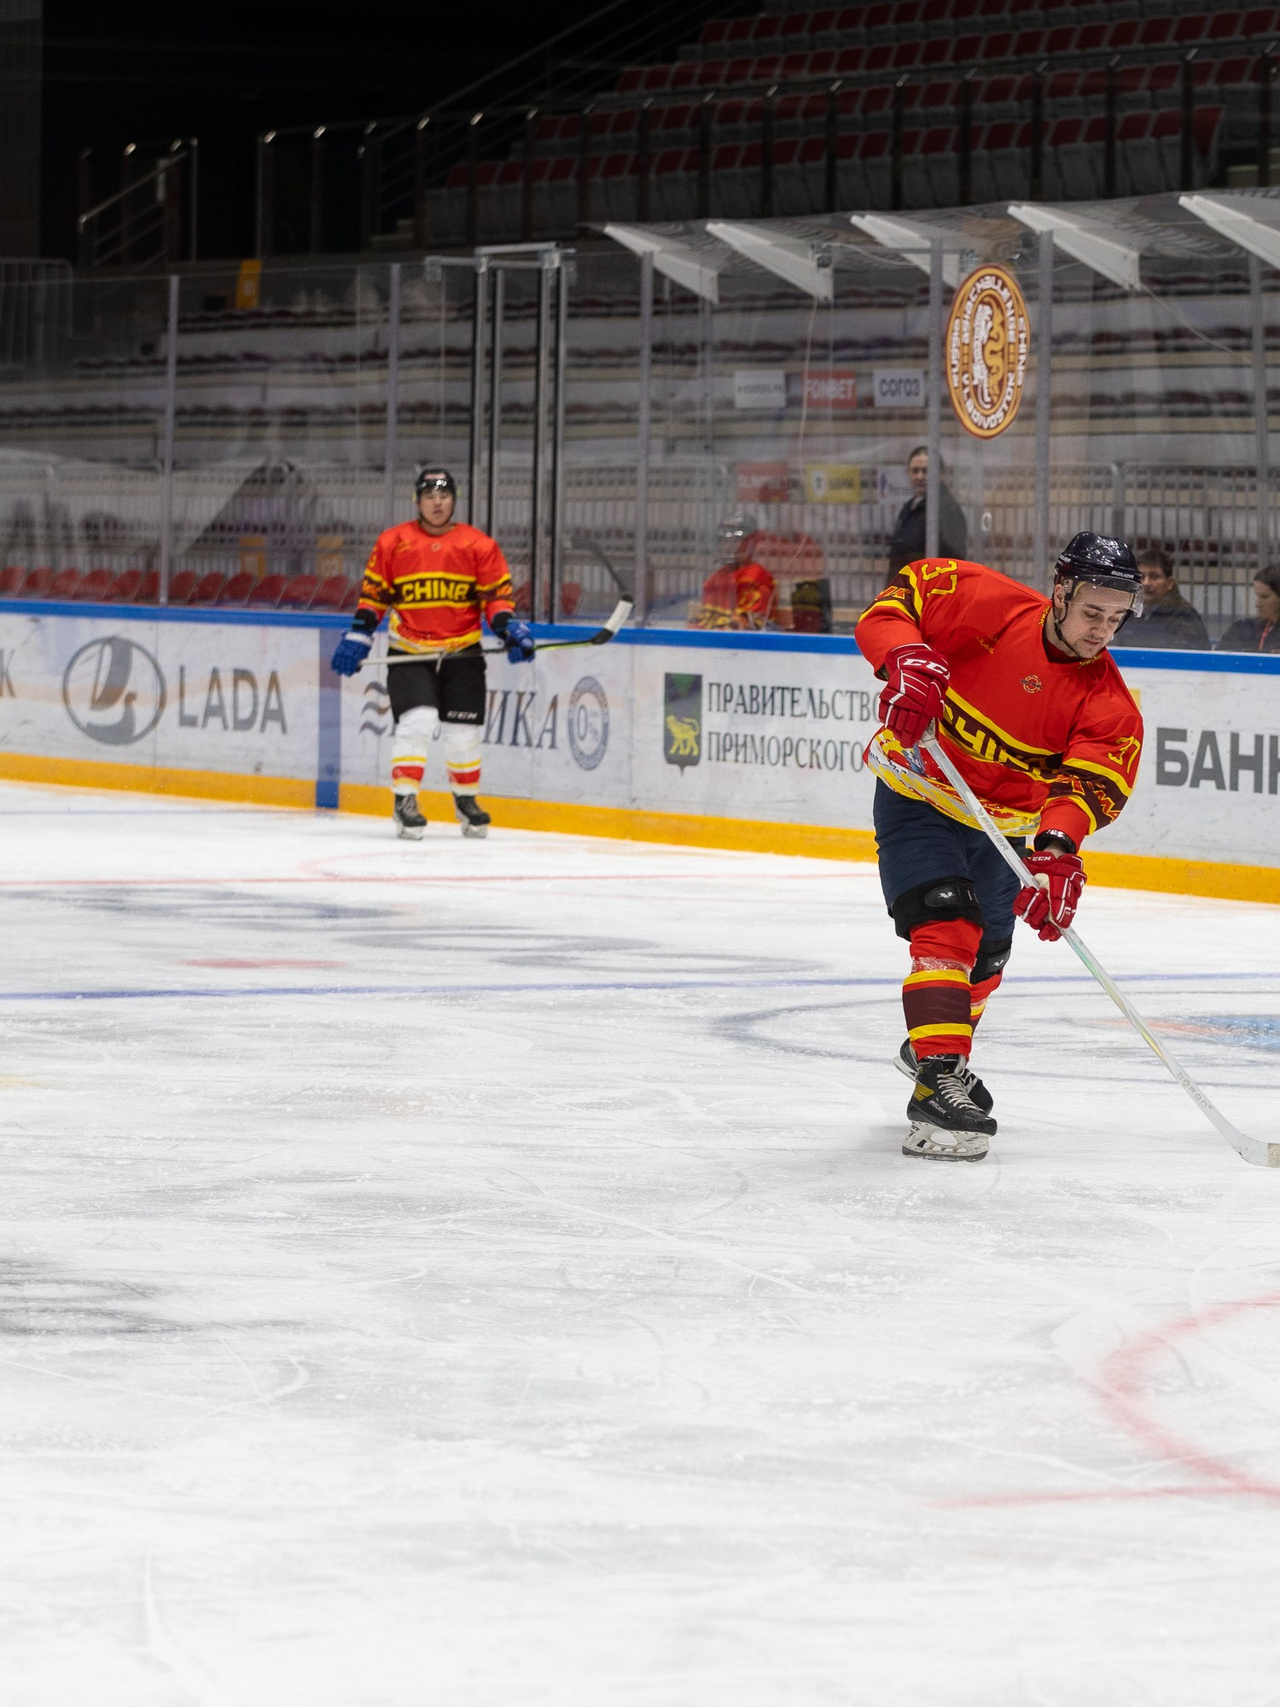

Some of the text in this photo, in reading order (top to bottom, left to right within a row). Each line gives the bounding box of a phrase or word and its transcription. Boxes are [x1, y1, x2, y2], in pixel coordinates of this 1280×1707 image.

[402, 579, 470, 602] CHINA
[1111, 570, 1134, 580] BAUER
[179, 664, 288, 735] LADA
[708, 731, 865, 773] ПРИМОРСКОГО
[1108, 735, 1141, 774] 37
[1032, 855, 1052, 863] CCM
